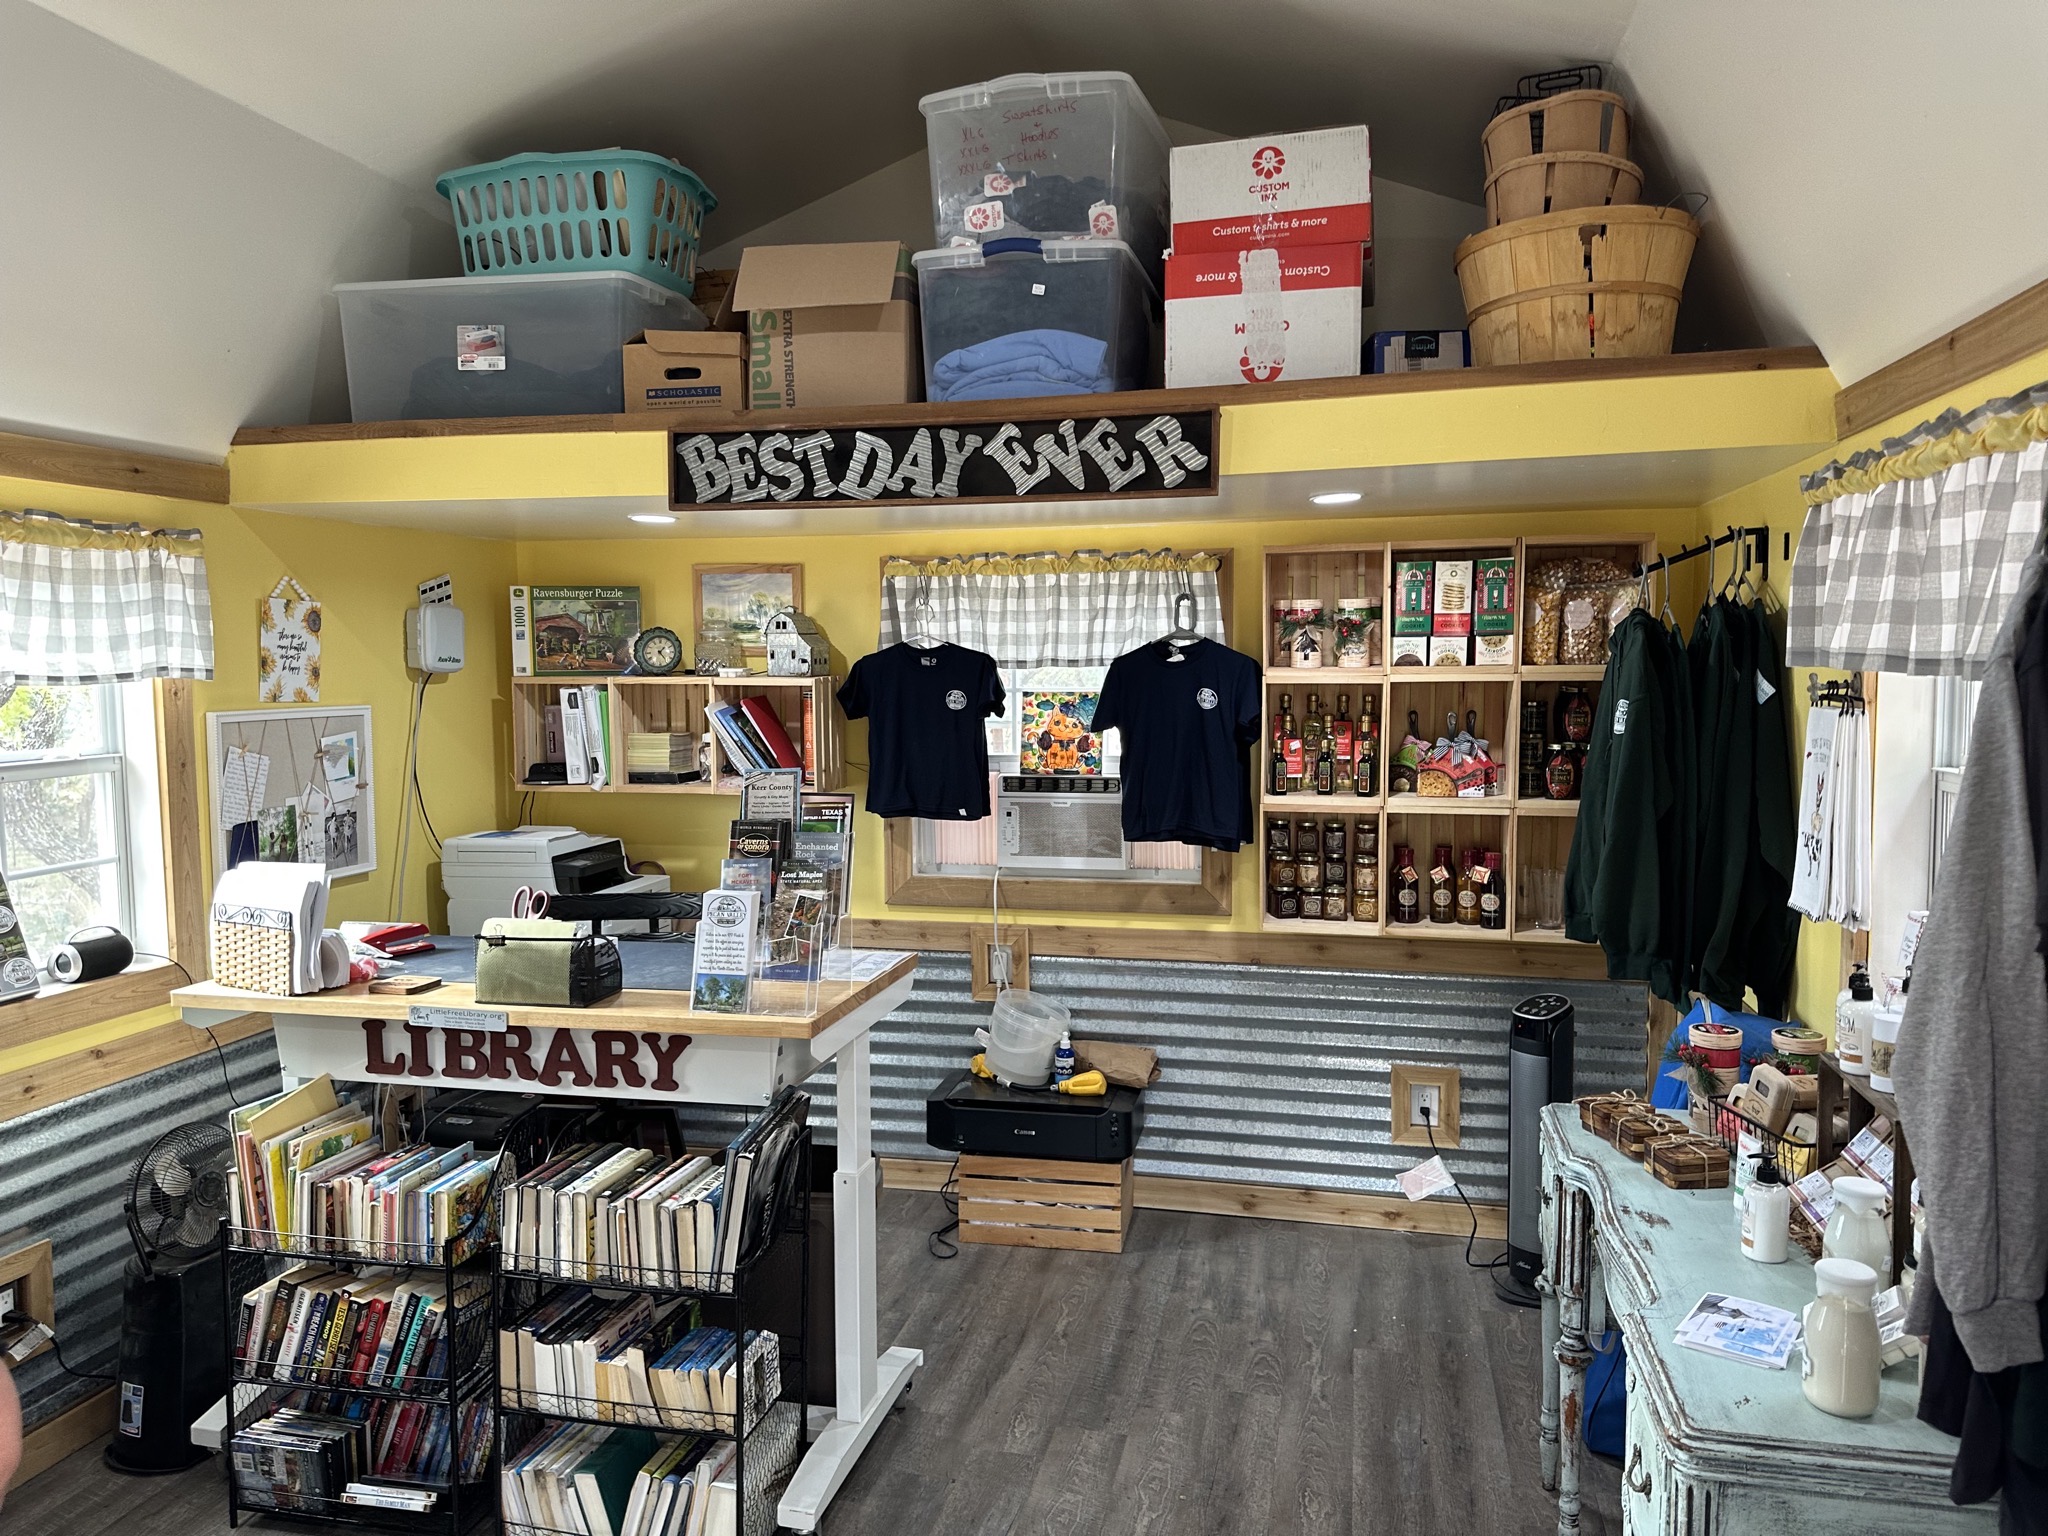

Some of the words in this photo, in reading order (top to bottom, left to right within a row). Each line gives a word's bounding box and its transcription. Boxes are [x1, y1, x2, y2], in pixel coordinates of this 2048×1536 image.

[1020, 128, 1059, 144] Hoodies
[1248, 181, 1290, 195] CUSTOM
[1261, 192, 1278, 202] INK
[1212, 224, 1251, 237] Custom
[1290, 218, 1300, 228] &
[1301, 217, 1328, 227] more
[1285, 264, 1331, 276] Custom
[1195, 272, 1226, 283] more
[783, 309, 793, 348] EXTRA
[751, 310, 782, 410] Small
[656, 387, 721, 398] SCHOLASTIC
[695, 398, 722, 407] possible
[676, 429, 835, 503] BEST
[838, 428, 982, 500] DAY
[982, 416, 1208, 496] EVER
[533, 588, 594, 599] Ravensburger
[595, 588, 623, 597] Puzzle
[514, 606, 526, 628] 1000
[739, 837, 769, 845] Caverns
[795, 842, 839, 851] Enchanted
[798, 871, 823, 879] Maples
[429, 1008, 502, 1021] LittleFreeLibrary.org
[362, 1019, 692, 1091] LIBRARY
[294, 1293, 306, 1324] GERRITSEN
[337, 1307, 346, 1320] TESS
[407, 1305, 415, 1317] TESS
[310, 1313, 321, 1336] BEACH
[328, 1320, 343, 1355] GERRITSEN
[303, 1335, 313, 1355] HOUSE
[401, 1327, 420, 1367] PATTERSON
